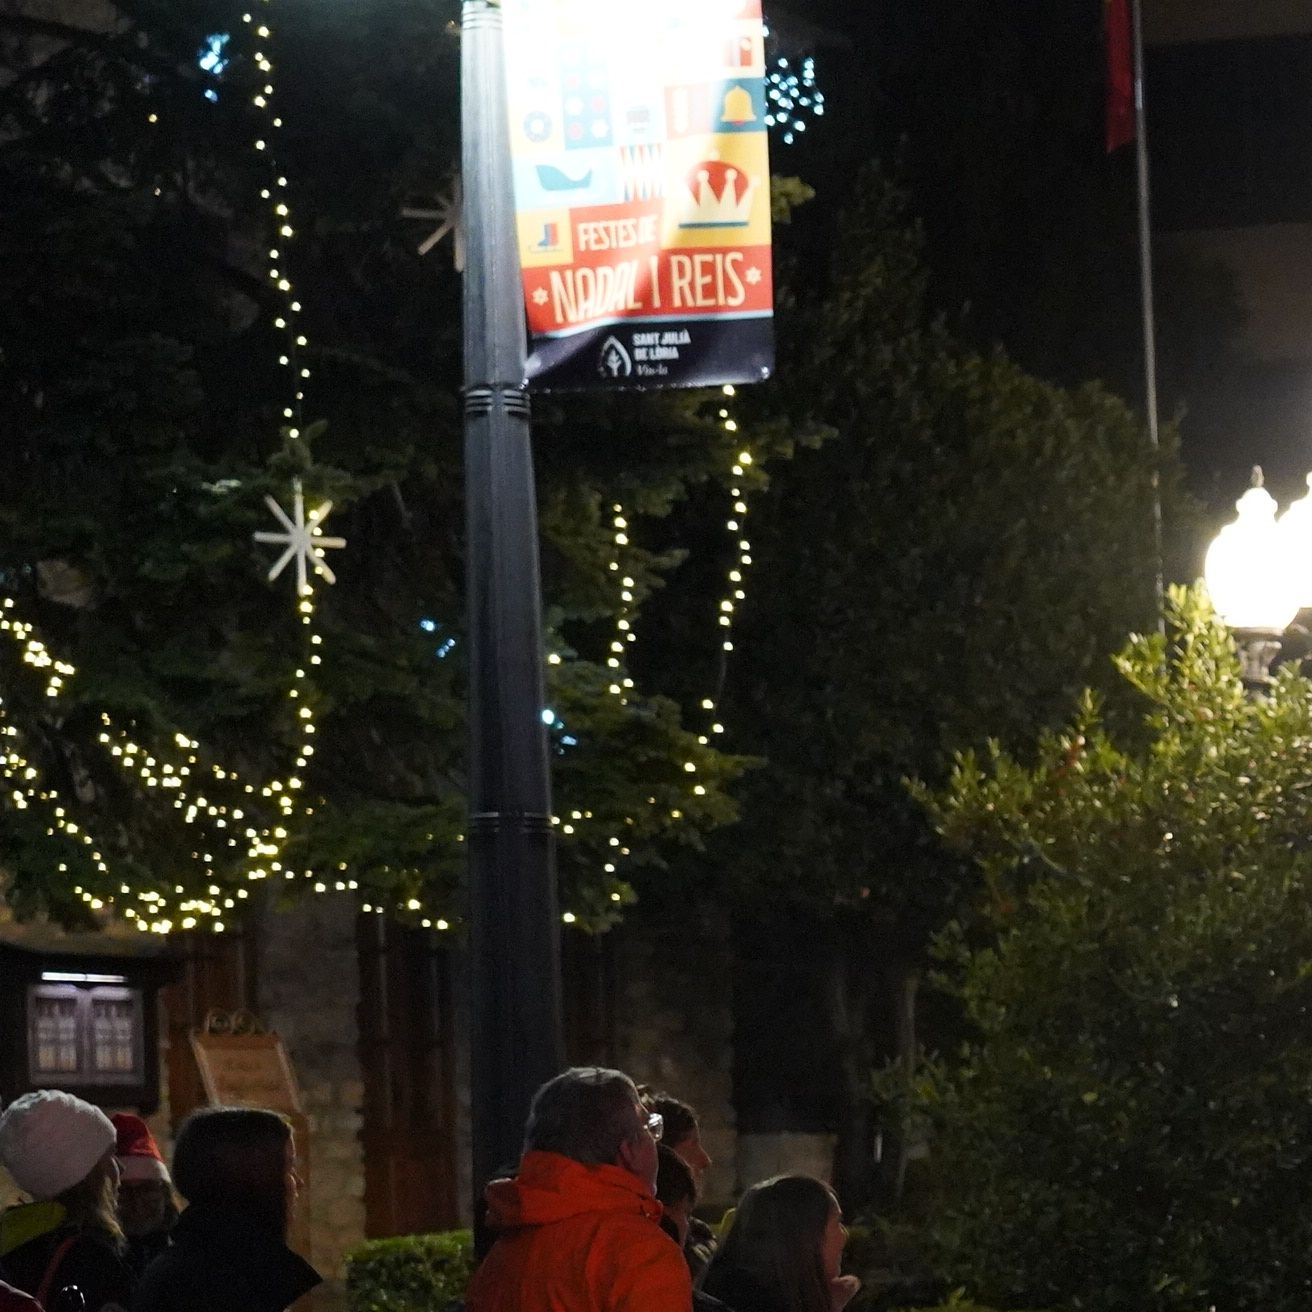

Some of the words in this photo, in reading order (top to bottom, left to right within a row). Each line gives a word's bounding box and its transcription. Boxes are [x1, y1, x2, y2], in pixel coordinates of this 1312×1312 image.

[578, 219, 638, 251] FESTES
[638, 215, 657, 244] DE
[550, 260, 643, 325] NADAL
[649, 255, 662, 309] I
[670, 252, 746, 309] REIS
[632, 332, 660, 347] SANT
